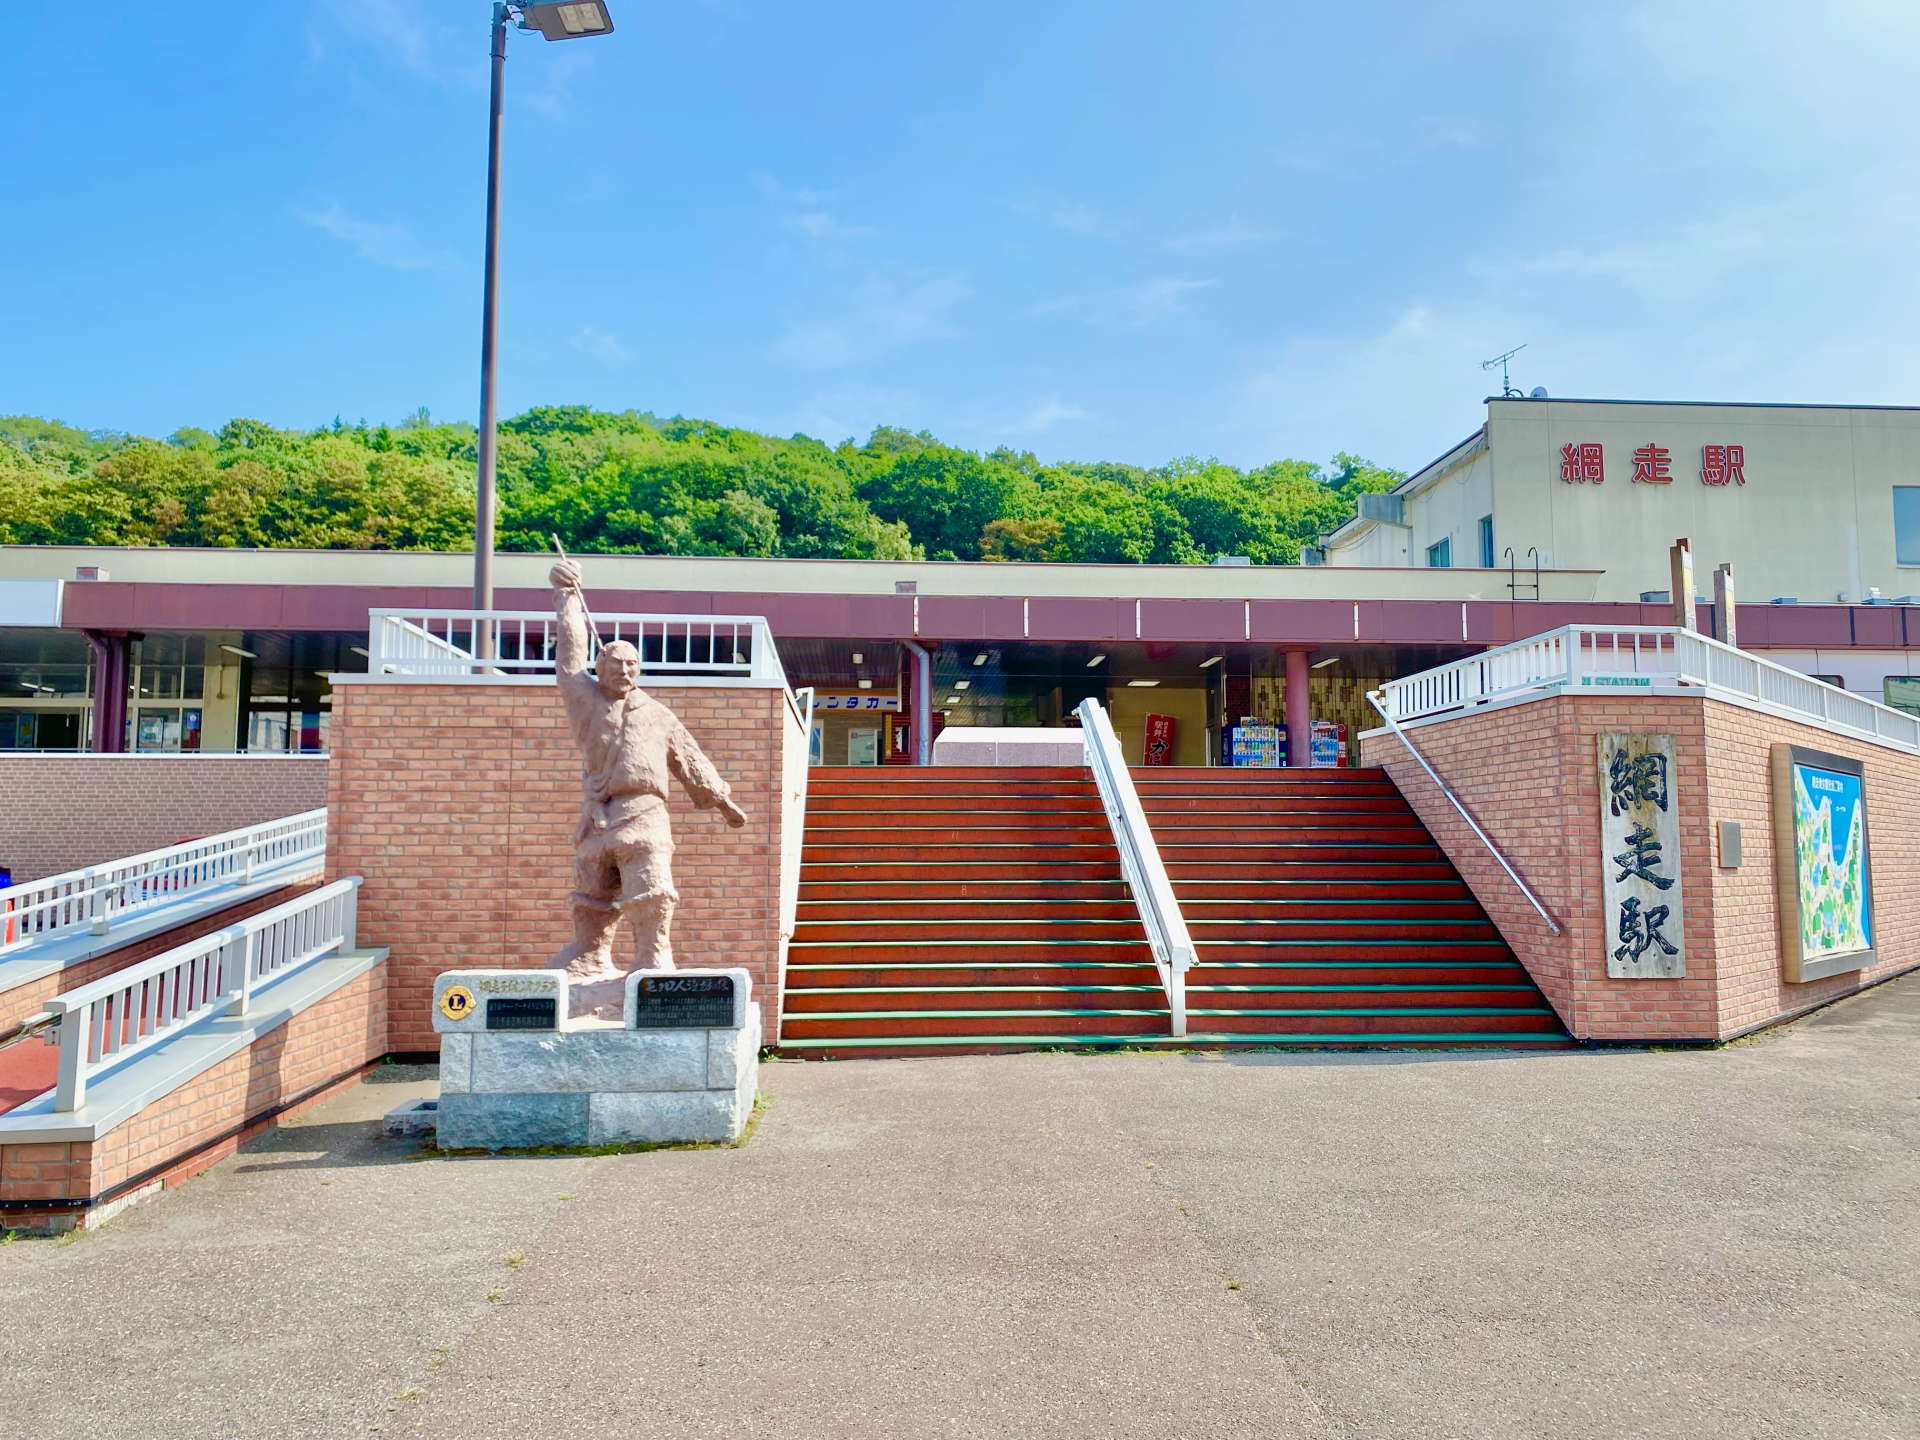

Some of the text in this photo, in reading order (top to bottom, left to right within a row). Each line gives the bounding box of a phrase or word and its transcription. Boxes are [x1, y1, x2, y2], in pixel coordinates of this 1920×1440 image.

[1562, 442, 1745, 485] 網走駅
[1610, 748, 1679, 963] 網走駅
[451, 996, 463, 1010] L
